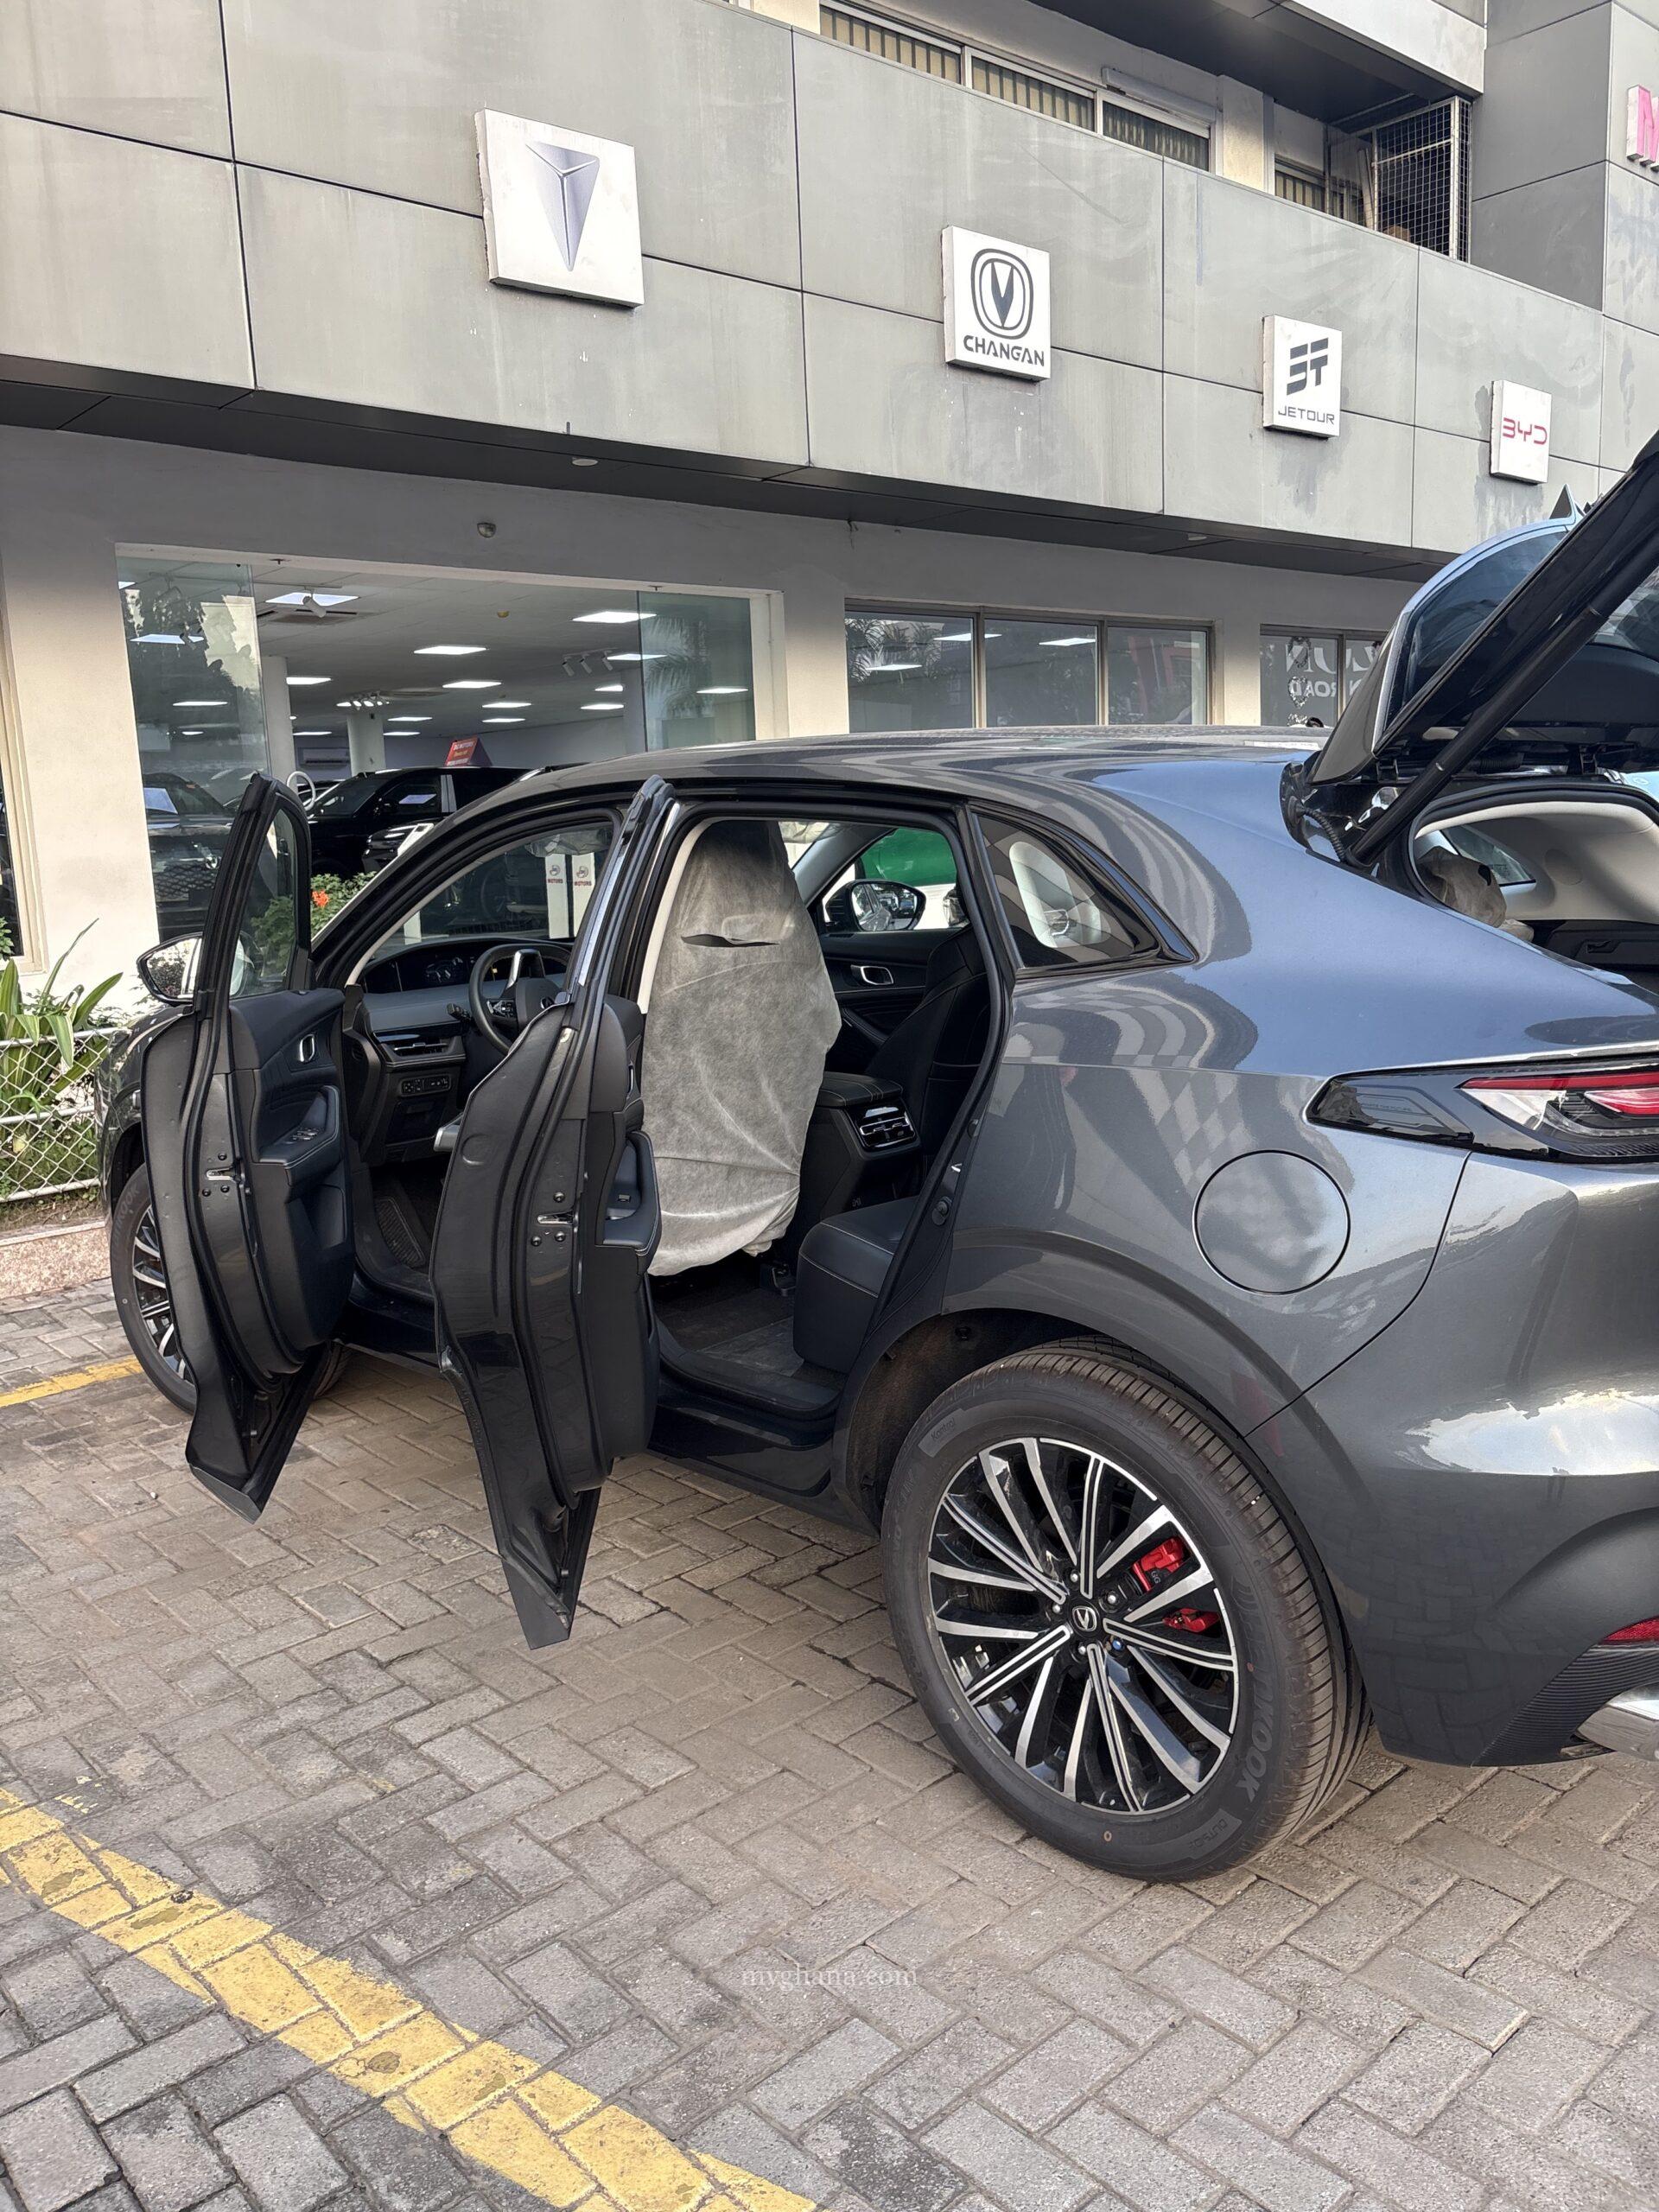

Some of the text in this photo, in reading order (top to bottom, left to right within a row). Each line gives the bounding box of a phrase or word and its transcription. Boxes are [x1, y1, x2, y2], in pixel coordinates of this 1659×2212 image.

[963, 335, 1044, 366] CHANGAN
[1278, 406, 1335, 425] JETOUR
[1503, 416, 1548, 445] BYD
